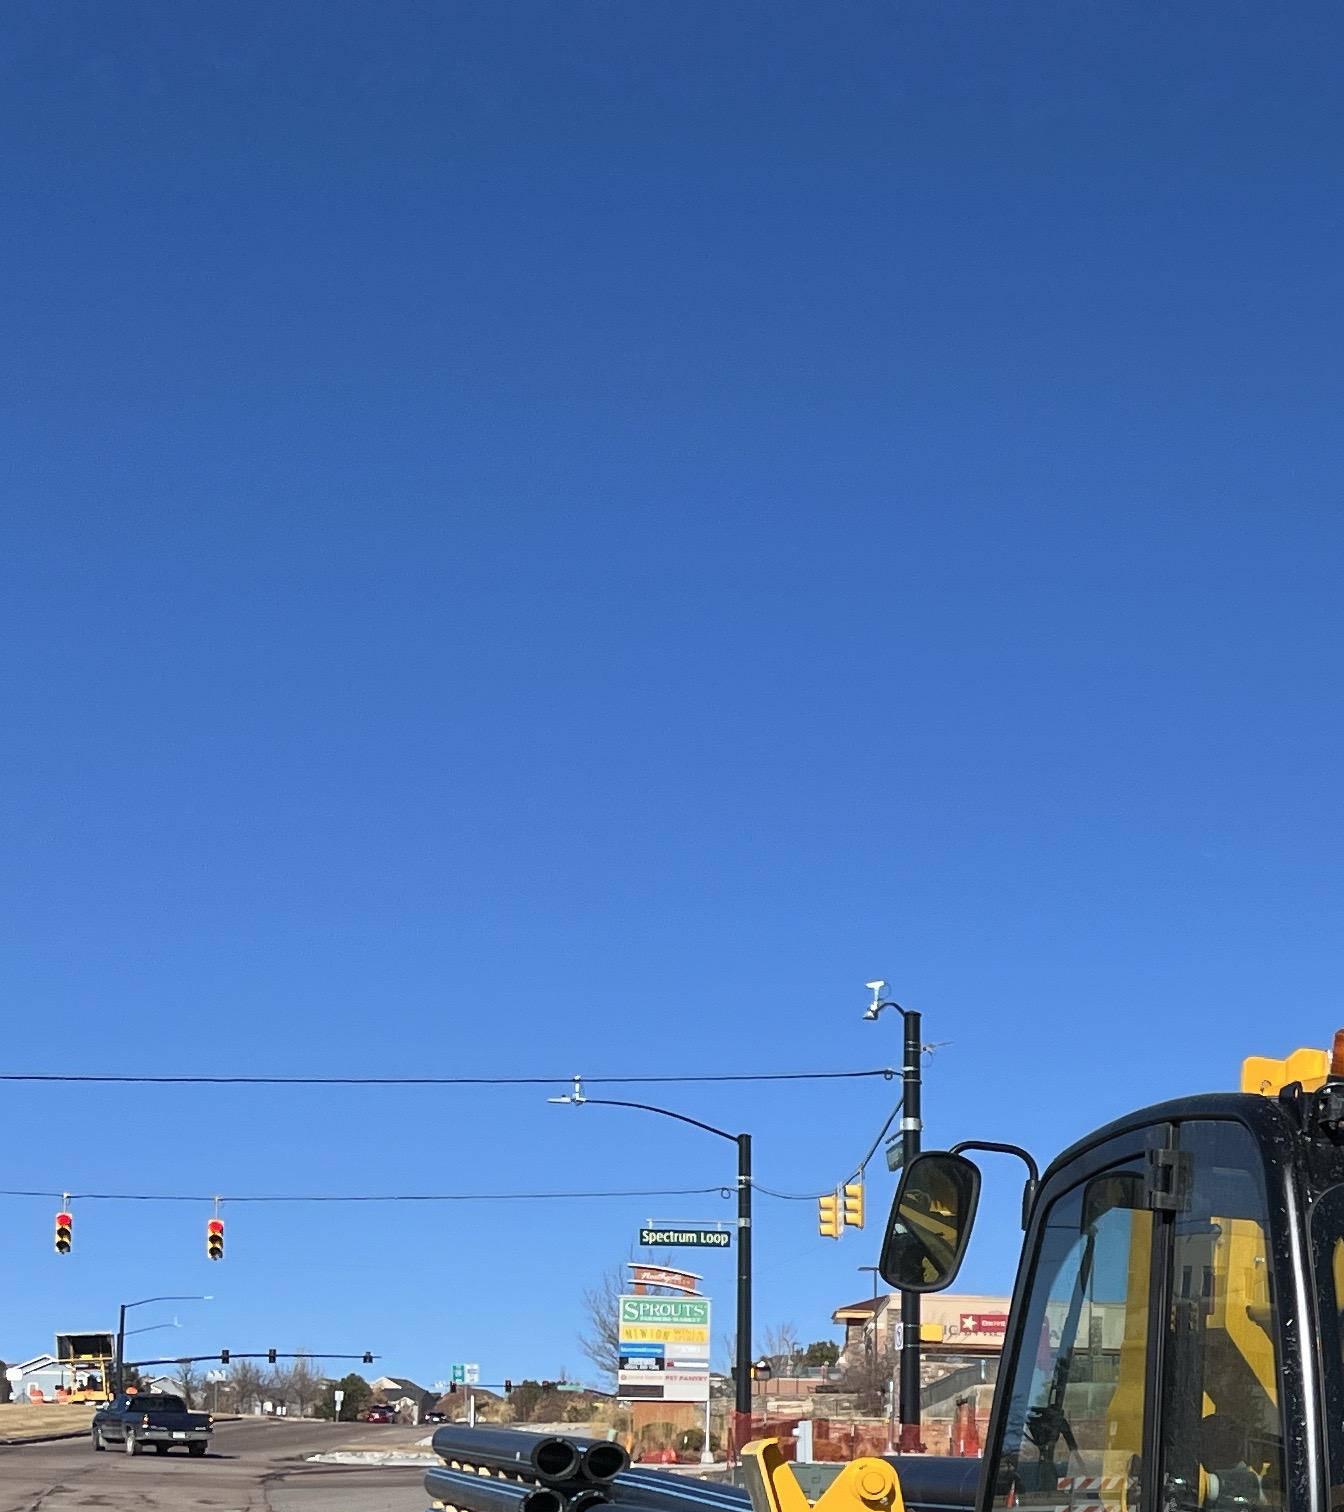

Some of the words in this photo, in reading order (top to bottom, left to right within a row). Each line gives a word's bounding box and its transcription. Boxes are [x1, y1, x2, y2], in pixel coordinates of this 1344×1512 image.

[642, 1230, 697, 1245] Spectrum
[700, 1231, 729, 1246] Loop
[623, 1301, 705, 1320] SPROUTS
